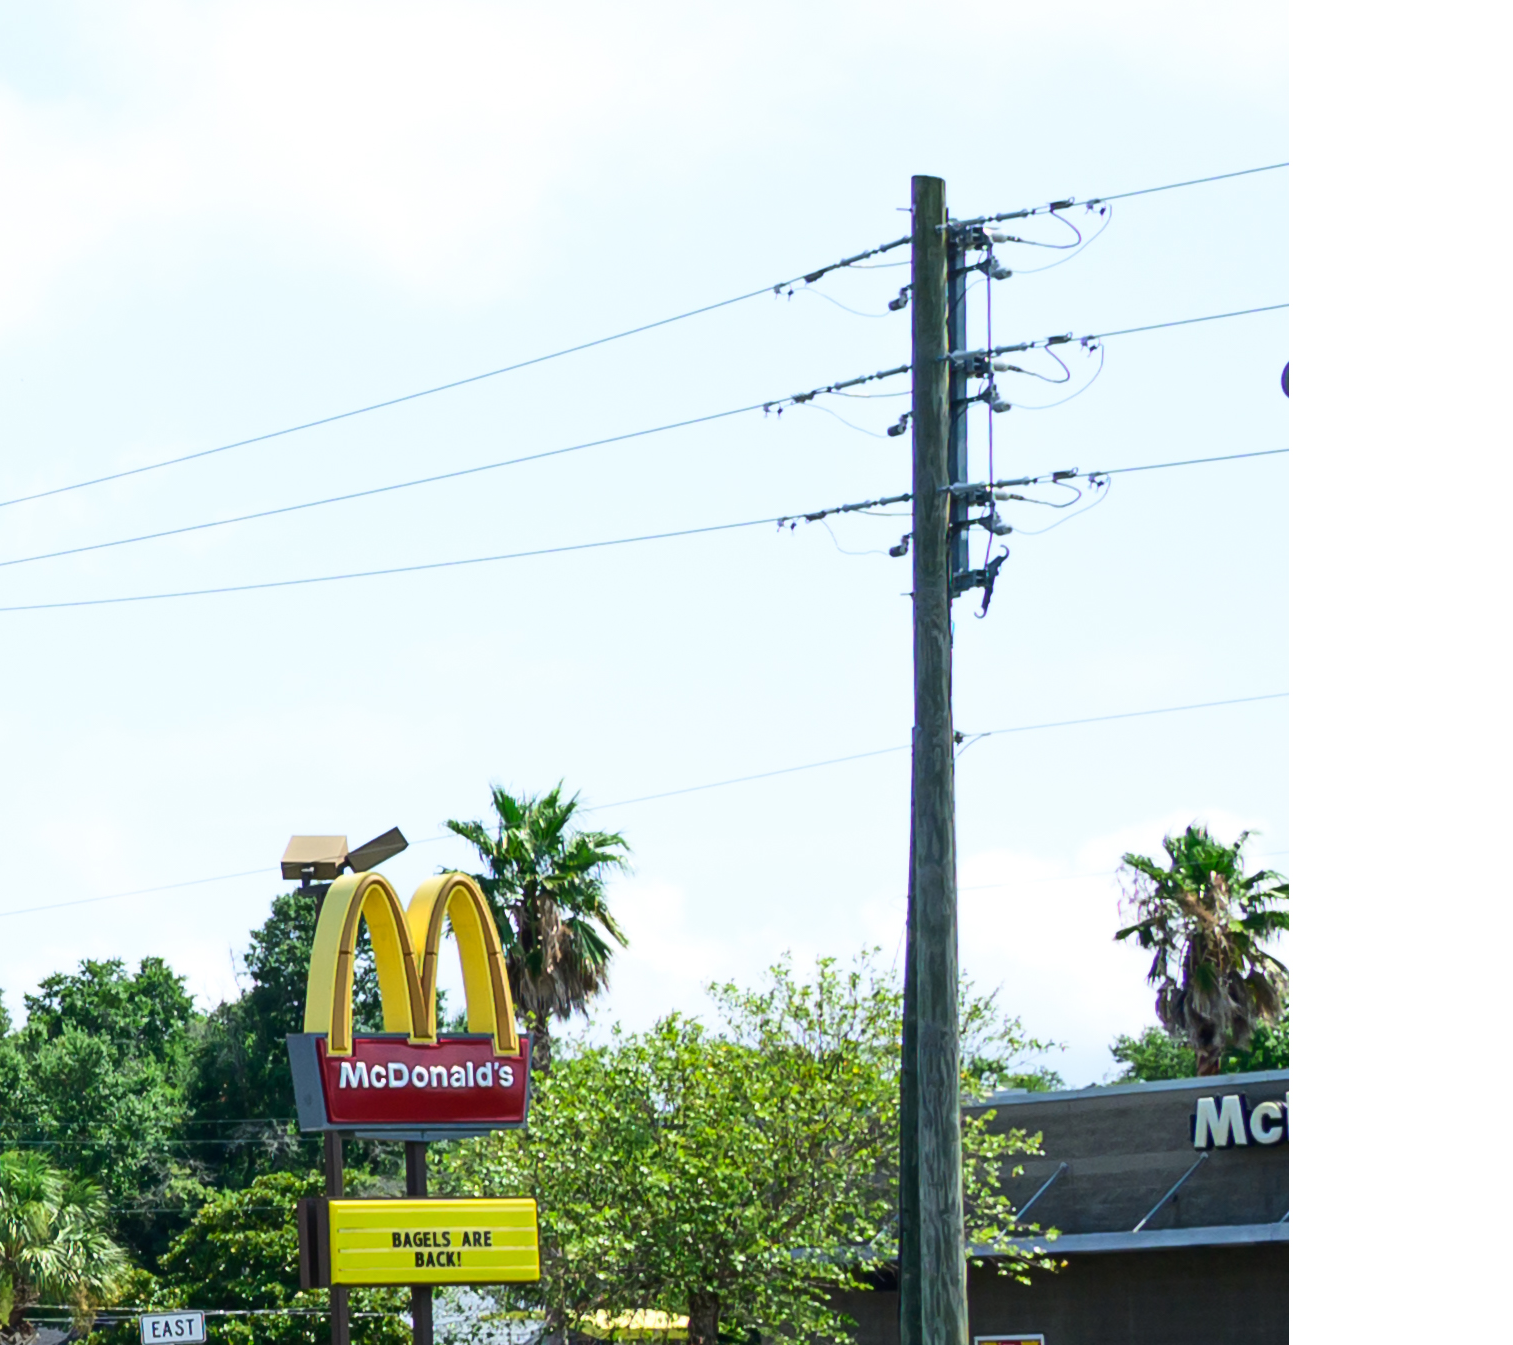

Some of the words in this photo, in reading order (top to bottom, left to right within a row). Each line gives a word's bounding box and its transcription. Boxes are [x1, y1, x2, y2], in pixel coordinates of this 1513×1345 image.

[338, 1061, 514, 1089] McDonald's
[1194, 1091, 1289, 1148] Mc
[391, 1231, 451, 1248] BAGELS
[462, 1230, 493, 1247] ARE
[414, 1251, 462, 1268] BACK!
[151, 1319, 194, 1338] EAST
